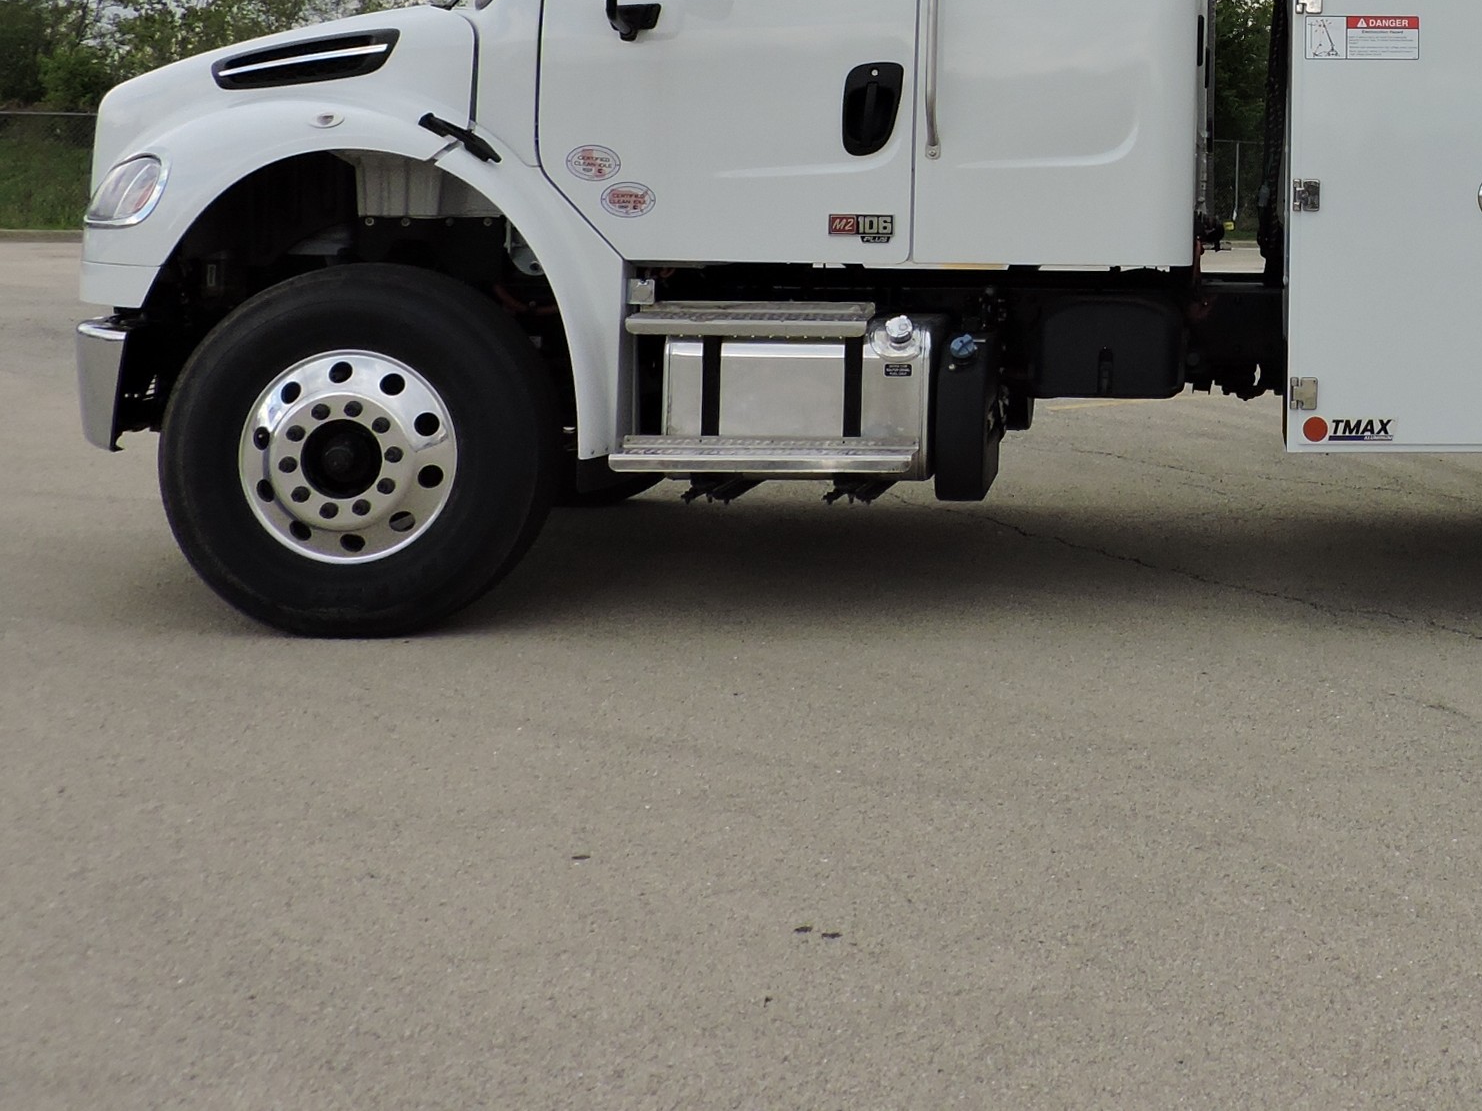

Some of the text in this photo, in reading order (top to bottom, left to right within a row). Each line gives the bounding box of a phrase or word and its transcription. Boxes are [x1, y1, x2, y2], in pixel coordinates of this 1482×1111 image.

[1369, 19, 1409, 27] DANGER
[832, 216, 892, 233] M2 106
[1331, 419, 1392, 435] TMAX
